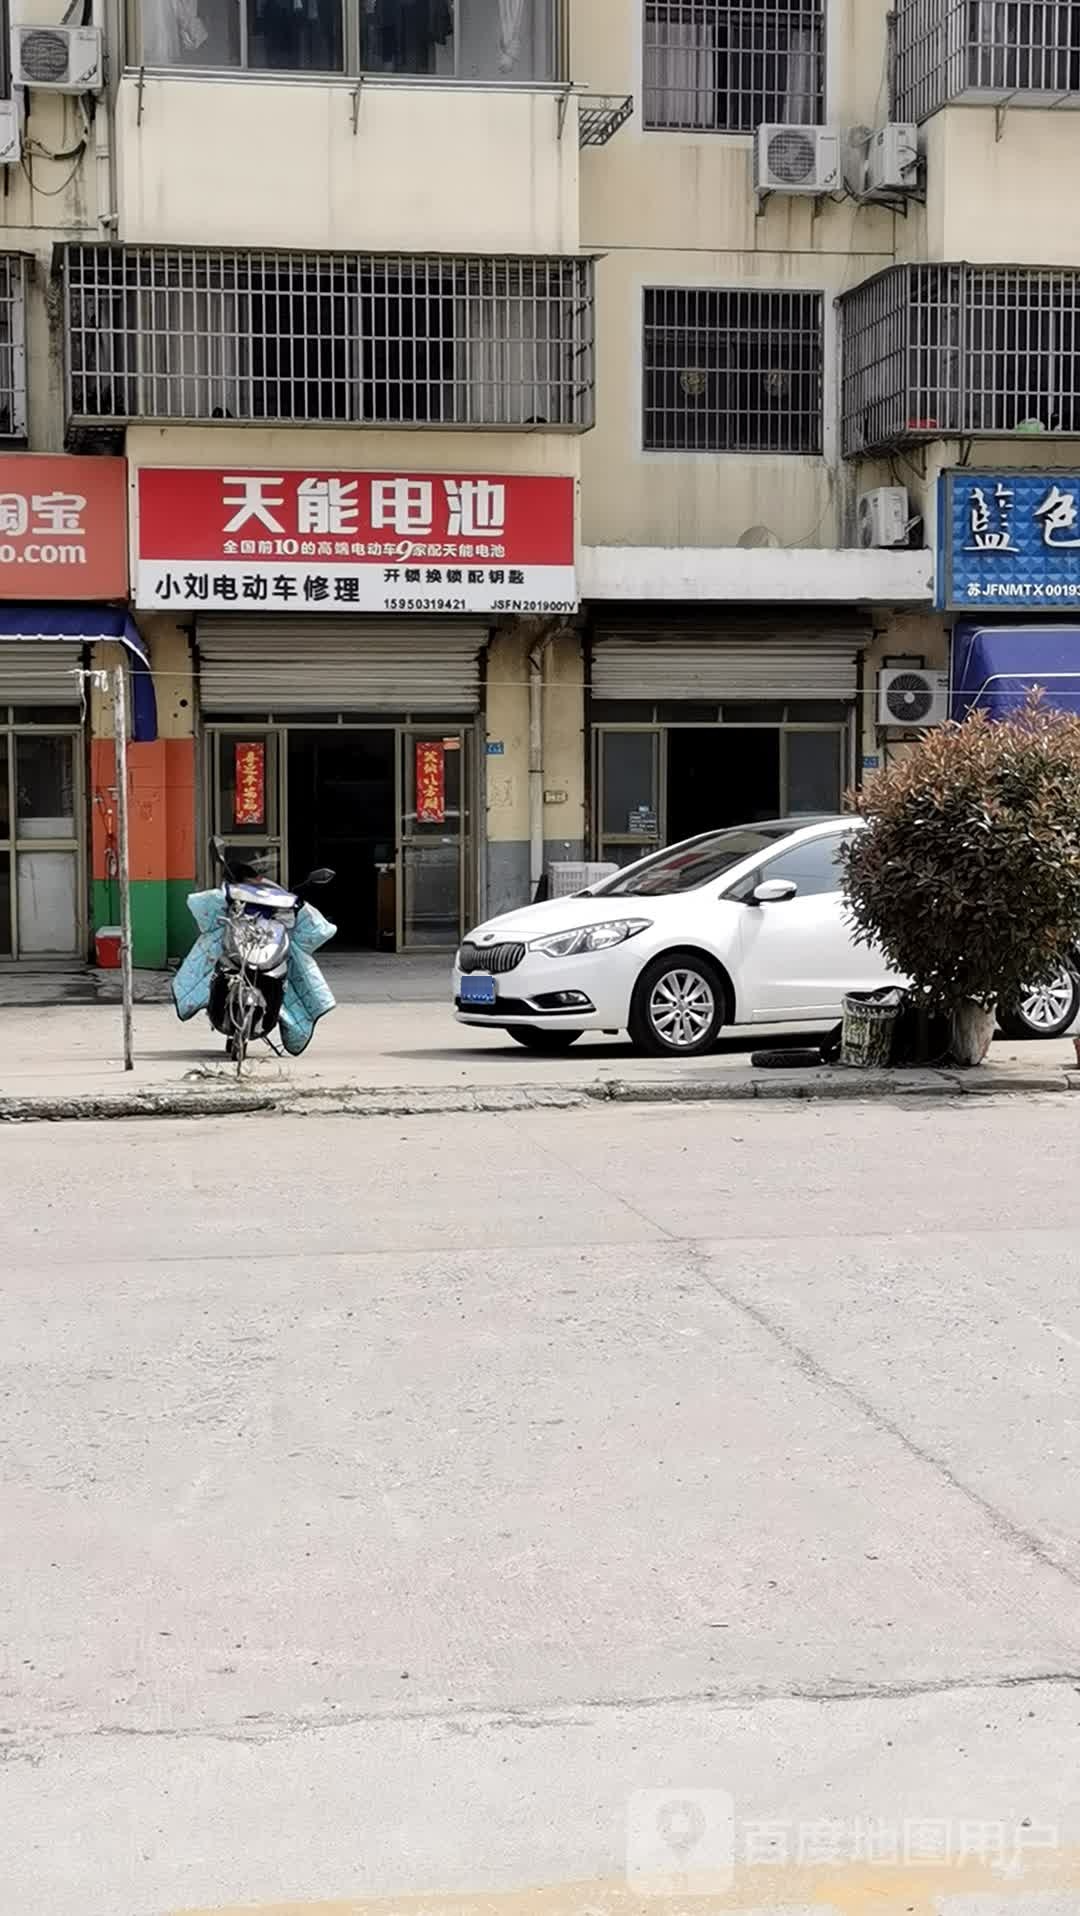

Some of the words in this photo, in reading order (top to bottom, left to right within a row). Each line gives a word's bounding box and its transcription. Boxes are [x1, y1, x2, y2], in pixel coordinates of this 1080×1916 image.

[222, 476, 506, 537] 天能电池
[0, 544, 87, 563] o.com
[223, 538, 506, 562] 全国前10的高端电动车9家配天能电池
[384, 568, 525, 585] 开锁换锁配钥匙
[155, 573, 361, 602] 小刘电动车修理
[383, 598, 467, 610] 15950319421
